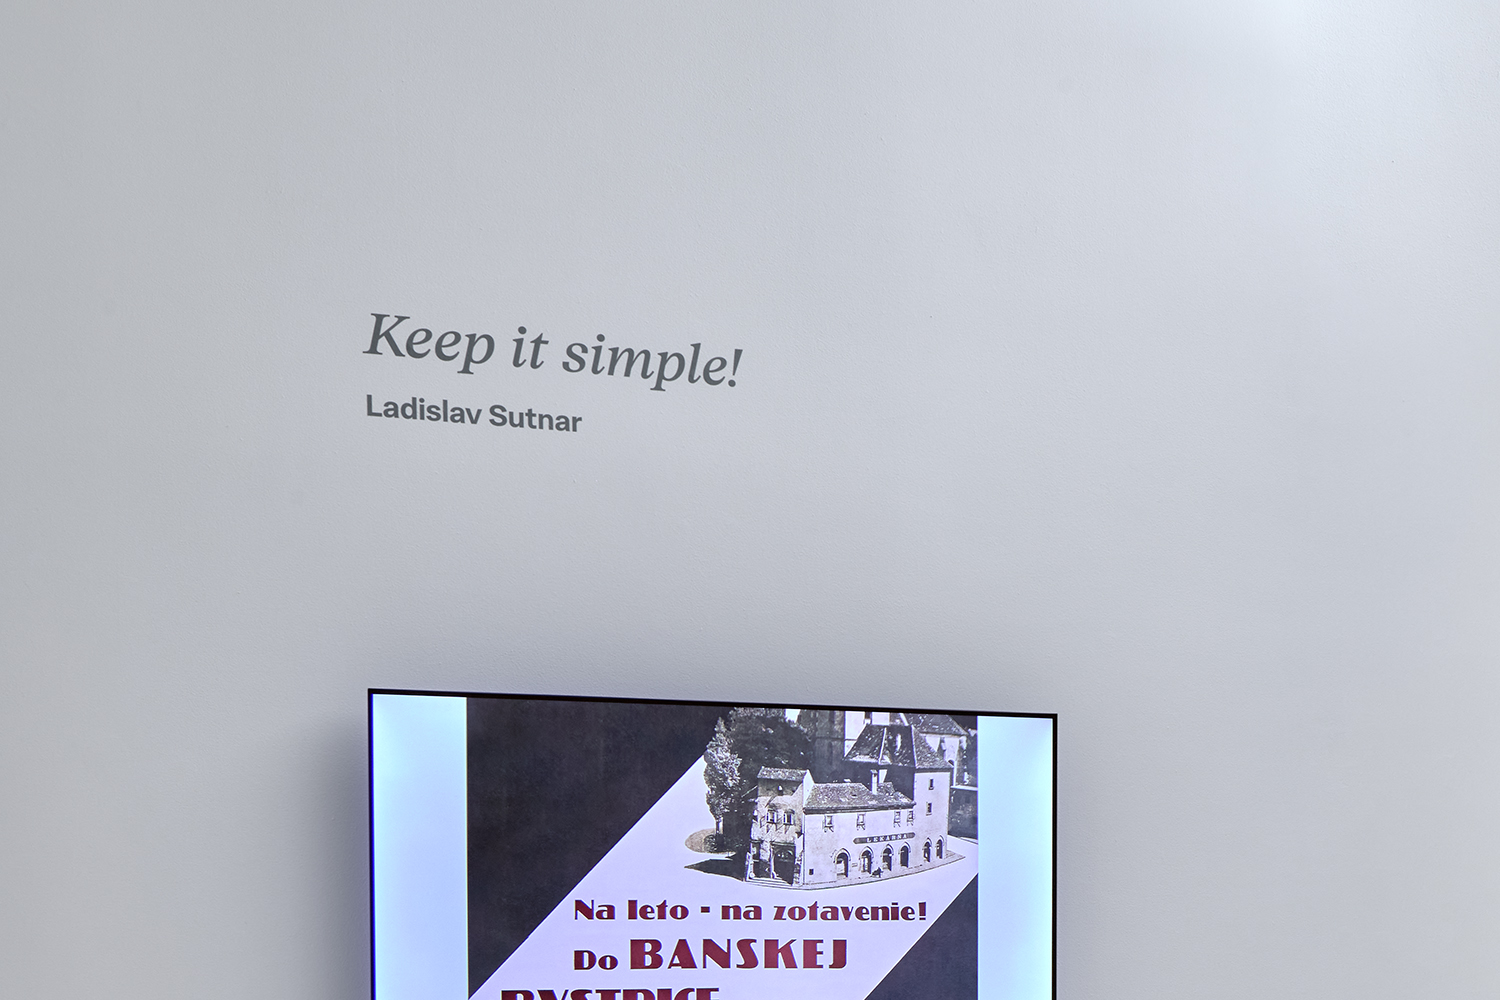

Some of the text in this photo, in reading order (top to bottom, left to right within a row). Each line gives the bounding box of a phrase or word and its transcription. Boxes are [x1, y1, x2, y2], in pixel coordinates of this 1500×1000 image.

[362, 313, 743, 392] Keep it simple!
[366, 394, 583, 432] Ladislav Sutnar
[574, 899, 616, 920] Na
[627, 899, 689, 920] leto
[721, 904, 762, 920] na
[773, 901, 927, 921] zotavenie!
[574, 939, 847, 970] Do BANSKEJ
